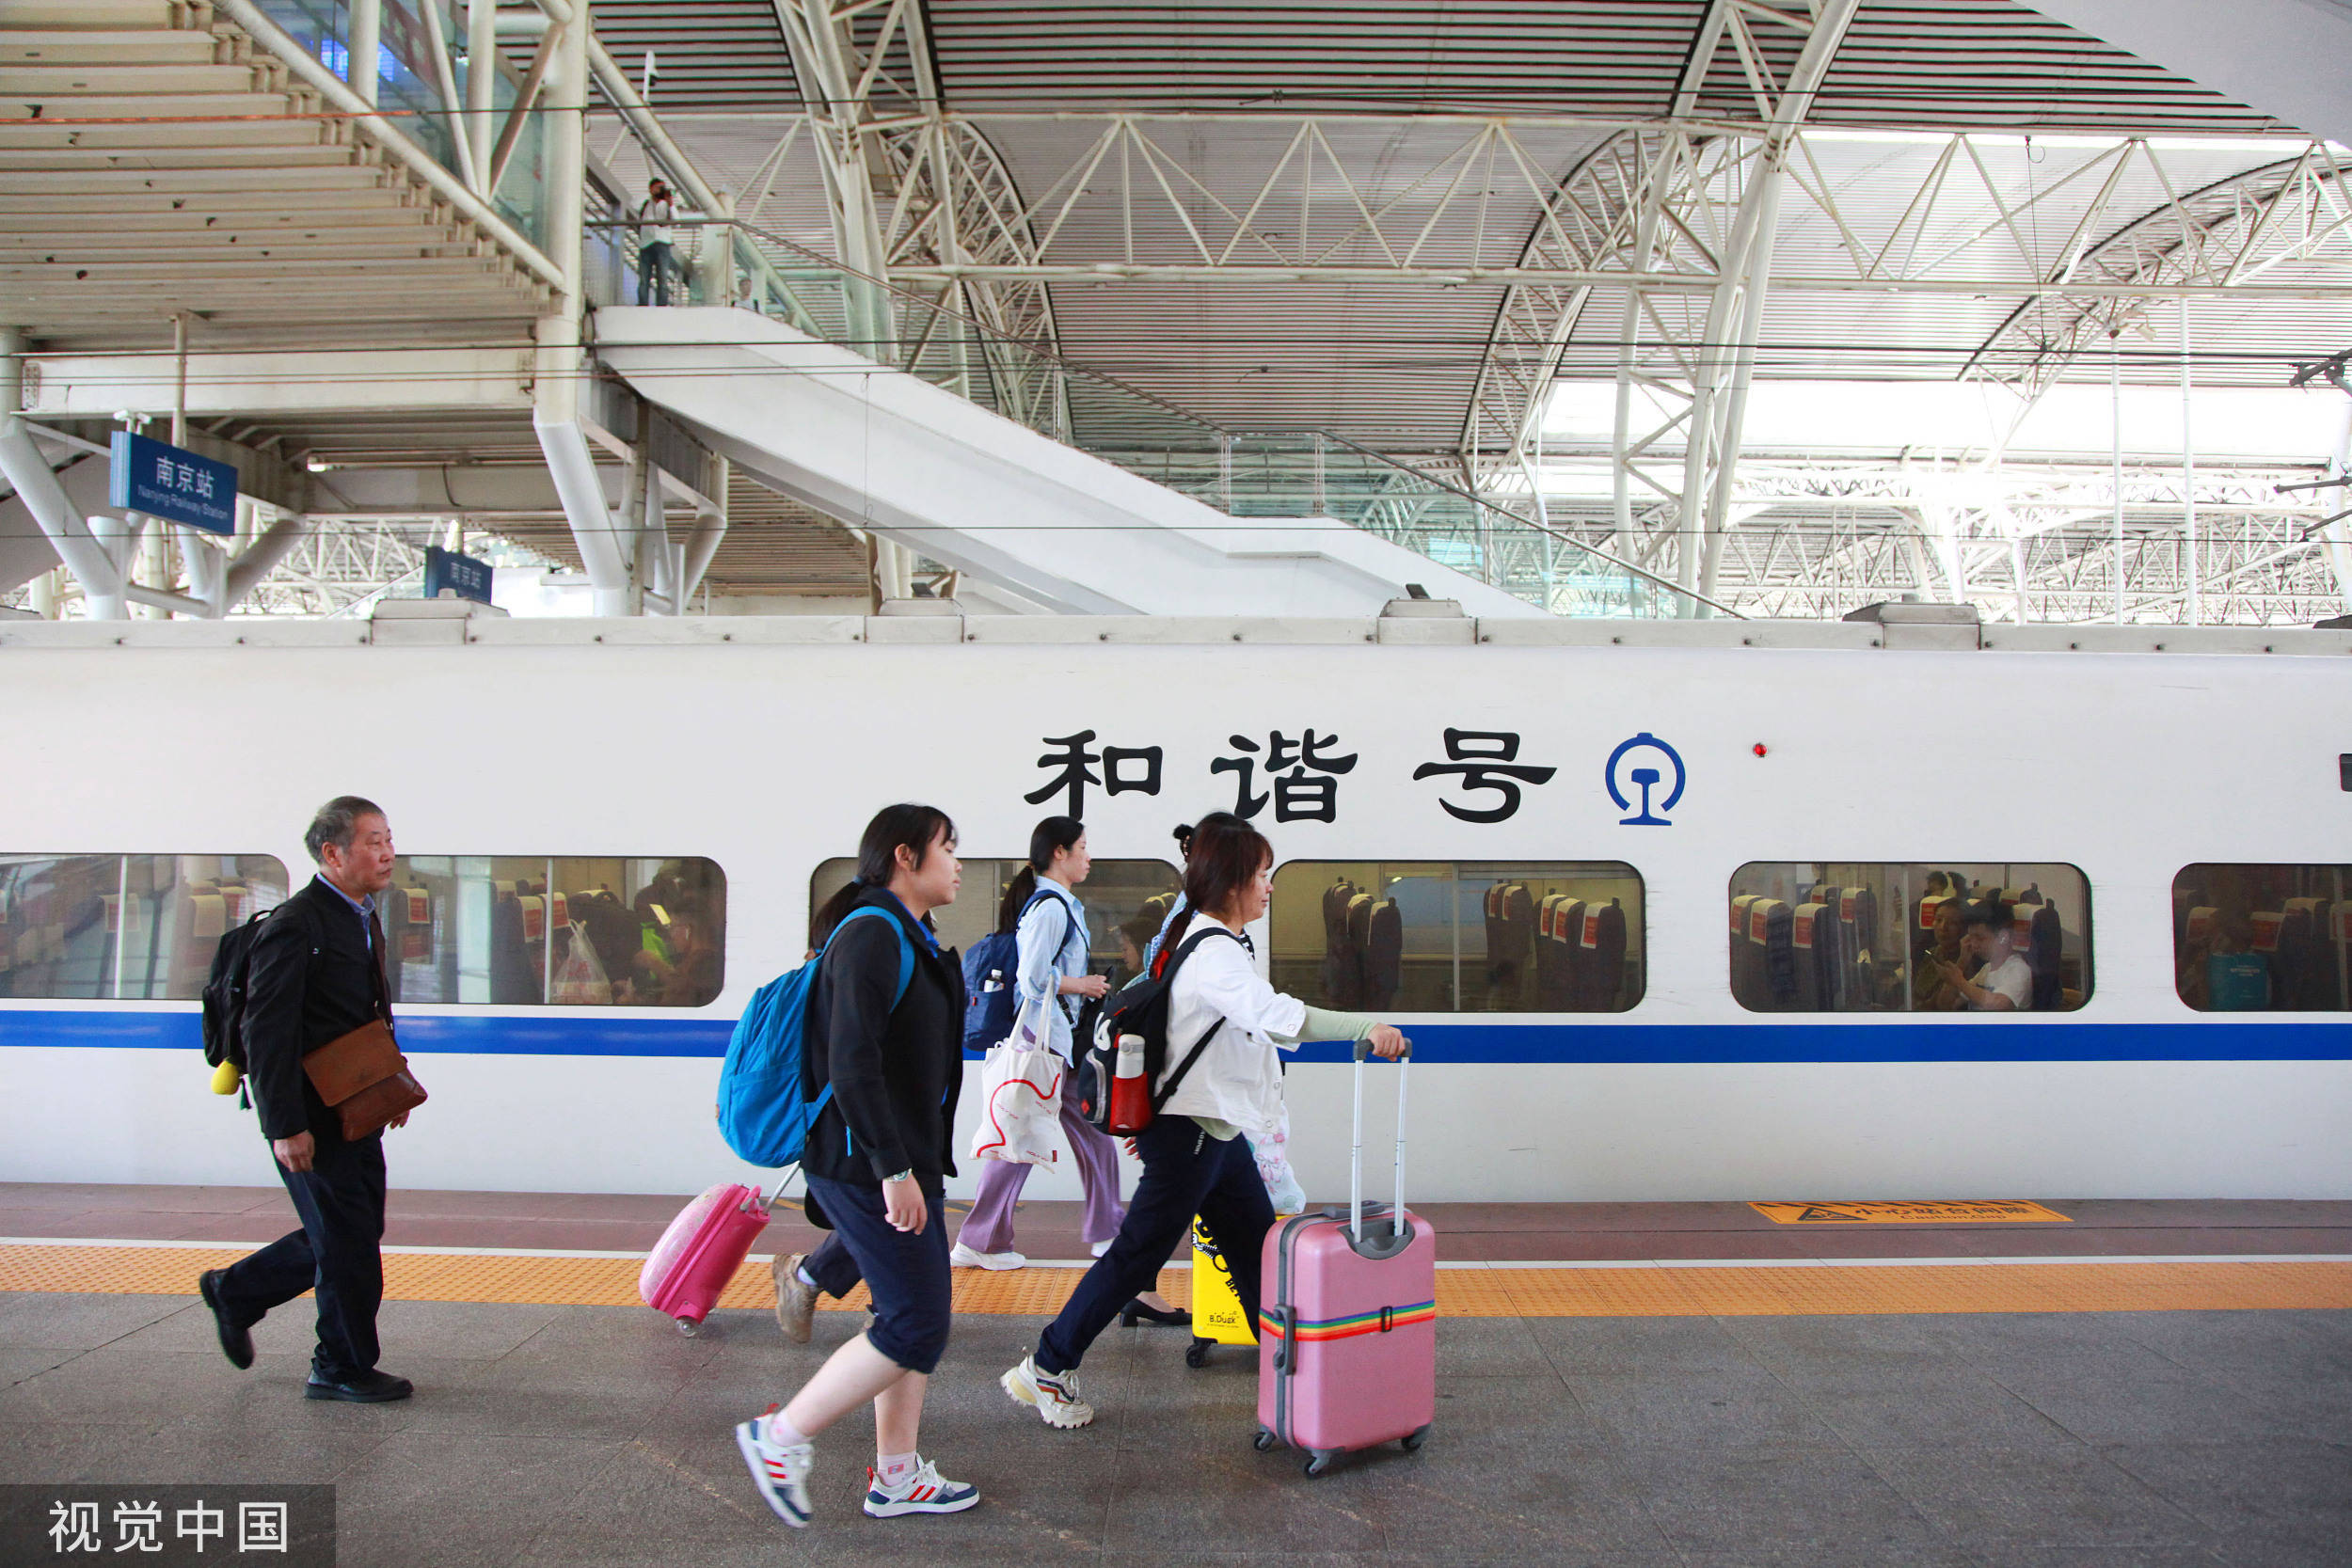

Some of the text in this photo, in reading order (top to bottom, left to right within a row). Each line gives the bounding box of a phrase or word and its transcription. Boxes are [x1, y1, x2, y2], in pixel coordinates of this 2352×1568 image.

[156, 456, 215, 499] 南京站
[137, 484, 228, 519] Nanjing Railway Station
[451, 562, 482, 590] 南京站
[1024, 728, 1558, 824] 和谐号
